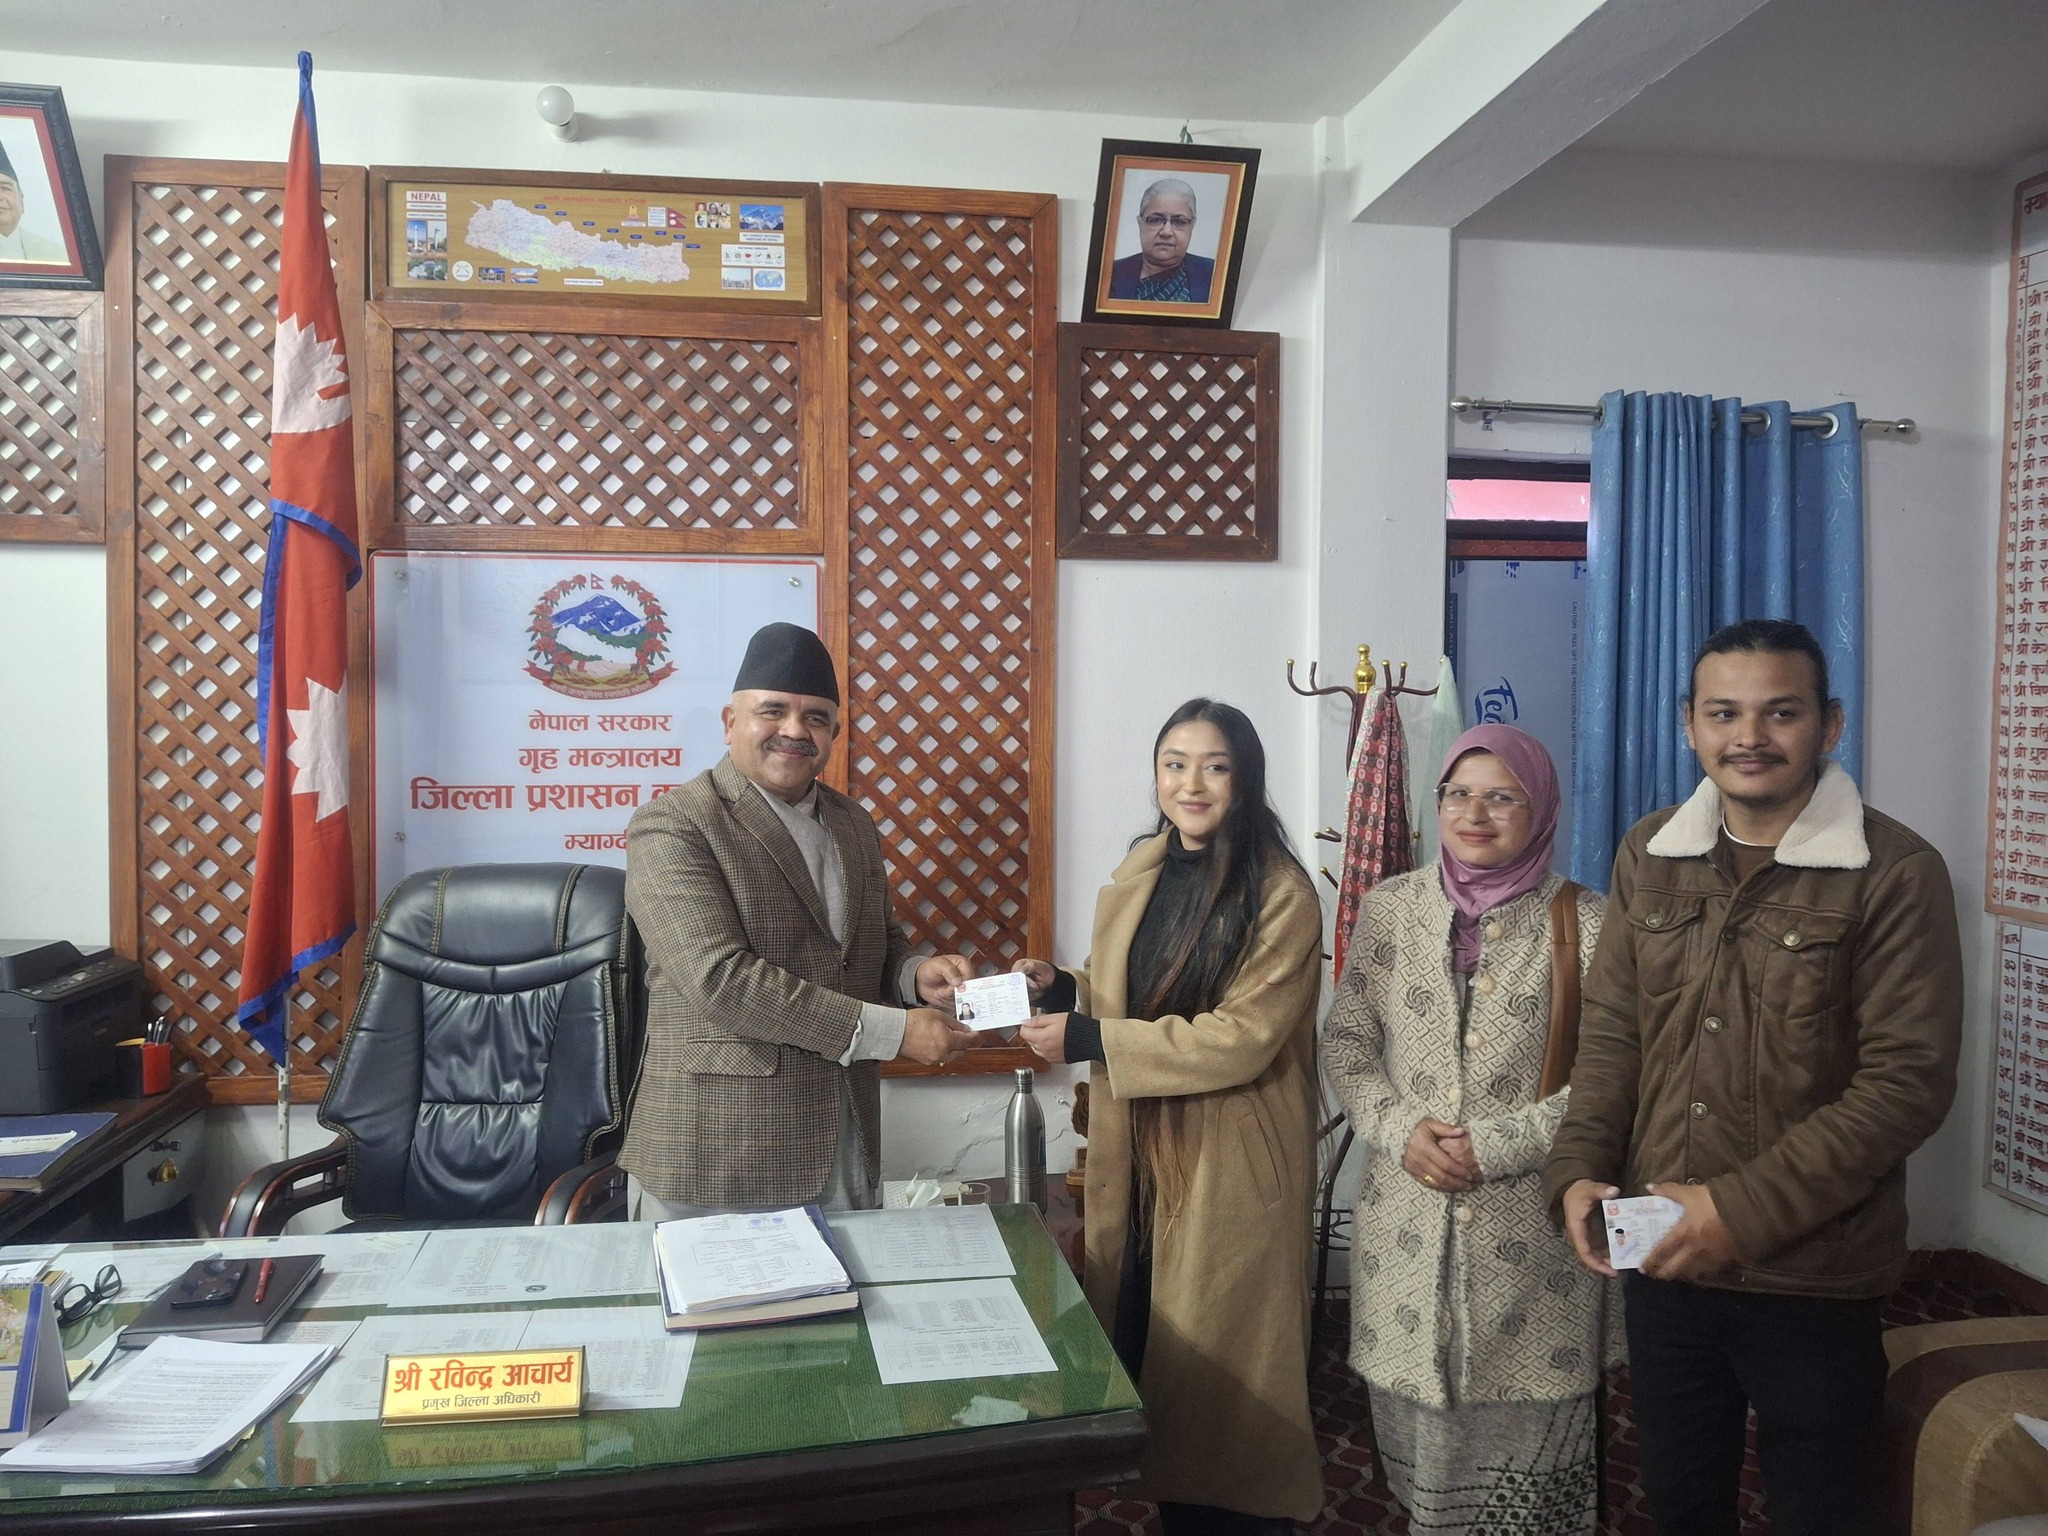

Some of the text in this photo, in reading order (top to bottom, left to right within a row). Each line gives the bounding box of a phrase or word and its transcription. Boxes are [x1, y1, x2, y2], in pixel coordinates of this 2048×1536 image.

[411, 192, 442, 201] NEPAL
[2028, 289, 2041, 307] श्री
[2028, 311, 2042, 326] श्री
[2026, 328, 2040, 342] श्री
[2027, 342, 2042, 356] श्री
[2027, 357, 2042, 373] श्री
[2027, 373, 2042, 390] श्री
[2028, 394, 2040, 410] श्री
[2024, 413, 2038, 430] श्री
[2024, 433, 2037, 450] श्री
[2023, 453, 2036, 472] श्री
[2022, 475, 2034, 491] श्री
[2021, 495, 2034, 511] श्री
[2021, 516, 2035, 532] श्री
[2019, 536, 2036, 552] श्री
[2019, 556, 2035, 572] श्री
[2018, 577, 2033, 593] श्री
[2018, 597, 2033, 614] श्री
[2017, 618, 2031, 634] श्री
[2016, 638, 2029, 655] श्री
[2014, 660, 2028, 676] श्री
[2014, 681, 2027, 697] श्री
[2014, 702, 2028, 718] श्री
[528, 710, 673, 733] नेपाल सरकार
[2013, 722, 2027, 738] श्री
[2014, 742, 2028, 758] श्री
[518, 747, 682, 774] गृह मन्त्रालय
[2013, 763, 2025, 779] श्री
[410, 776, 515, 811] जिल्ला
[526, 783, 641, 812] प्रशासन
[2011, 785, 2024, 801] श्री
[2011, 805, 2023, 822] श्री
[2010, 825, 2023, 842] श्री
[2008, 848, 2023, 865] श्री
[2006, 866, 2019, 882] श्री
[2005, 886, 2017, 901] श्री
[2022, 959, 2033, 974] श्री
[2022, 976, 2033, 991] श्री
[2022, 995, 2033, 1009] श्री
[2022, 1014, 2032, 1027] श्री
[2020, 1031, 2032, 1045] श्री
[2019, 1050, 2032, 1065] श्री
[2019, 1071, 2032, 1087] श्री
[2019, 1093, 2031, 1108] श्री
[2014, 1112, 2027, 1127] श्री
[2014, 1129, 2025, 1143] श्री
[2013, 1147, 2024, 1162] श्री
[394, 1361, 422, 1393] श्री
[429, 1359, 496, 1391] रविन्द्र
[502, 1355, 574, 1387] आचार्य
[421, 1391, 541, 1411] प्रमुख जिल्ला अधिकारी
